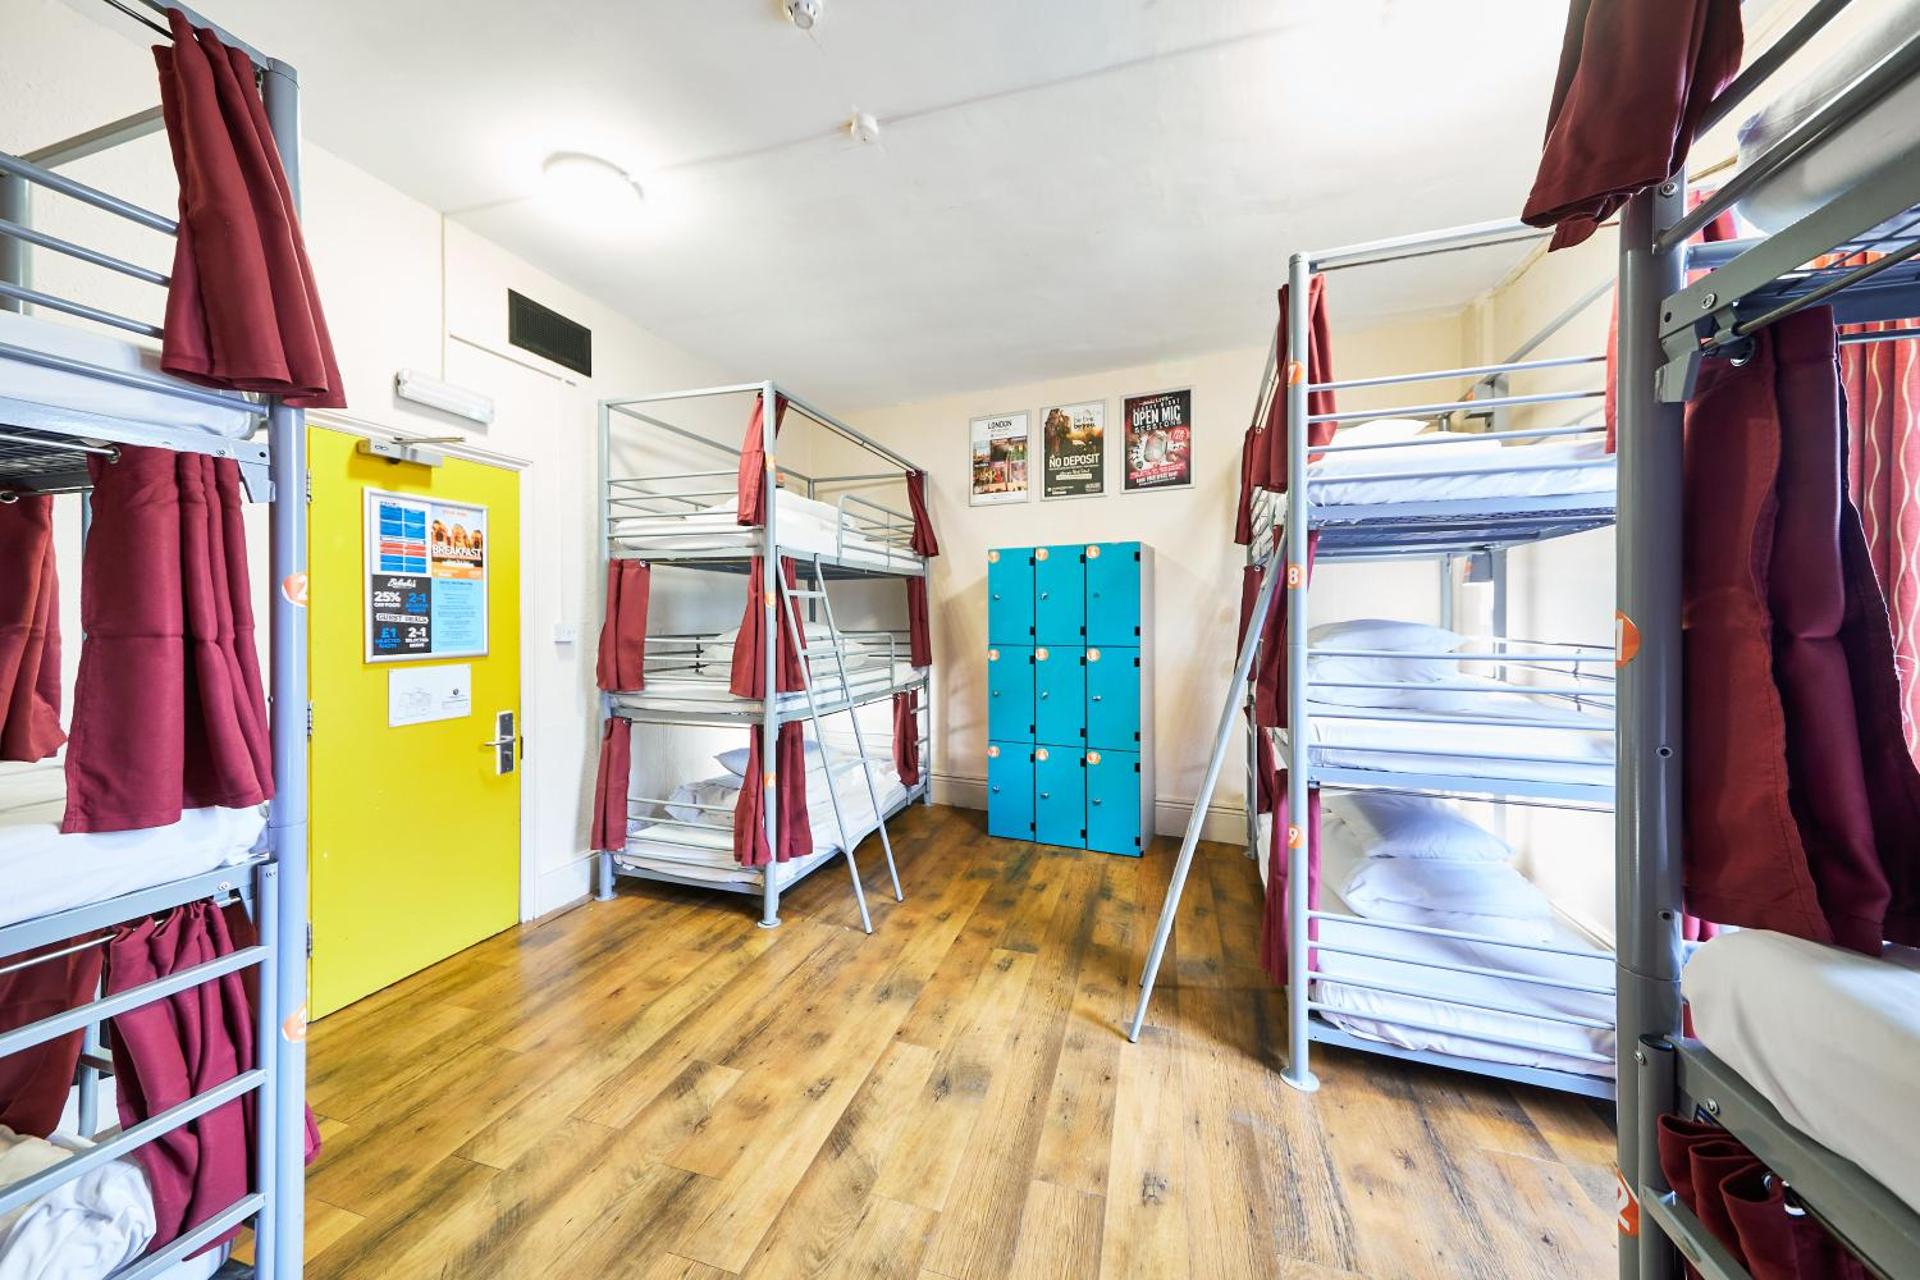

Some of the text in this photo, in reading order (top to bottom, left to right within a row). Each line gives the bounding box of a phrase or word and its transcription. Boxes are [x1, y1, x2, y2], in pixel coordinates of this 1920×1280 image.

[1133, 405, 1181, 427] OPEN MIC
[988, 420, 1011, 430] LONDON
[1049, 457, 1062, 468] NO
[1063, 453, 1101, 467] DEPOSIT
[432, 544, 482, 558] BREAKFAST
[1289, 567, 1299, 584] 8
[374, 591, 401, 602] 25%
[408, 592, 427, 603] 2-1
[377, 613, 402, 623] GUEST
[408, 627, 427, 638] 2-1
[1289, 827, 1299, 844] 9
